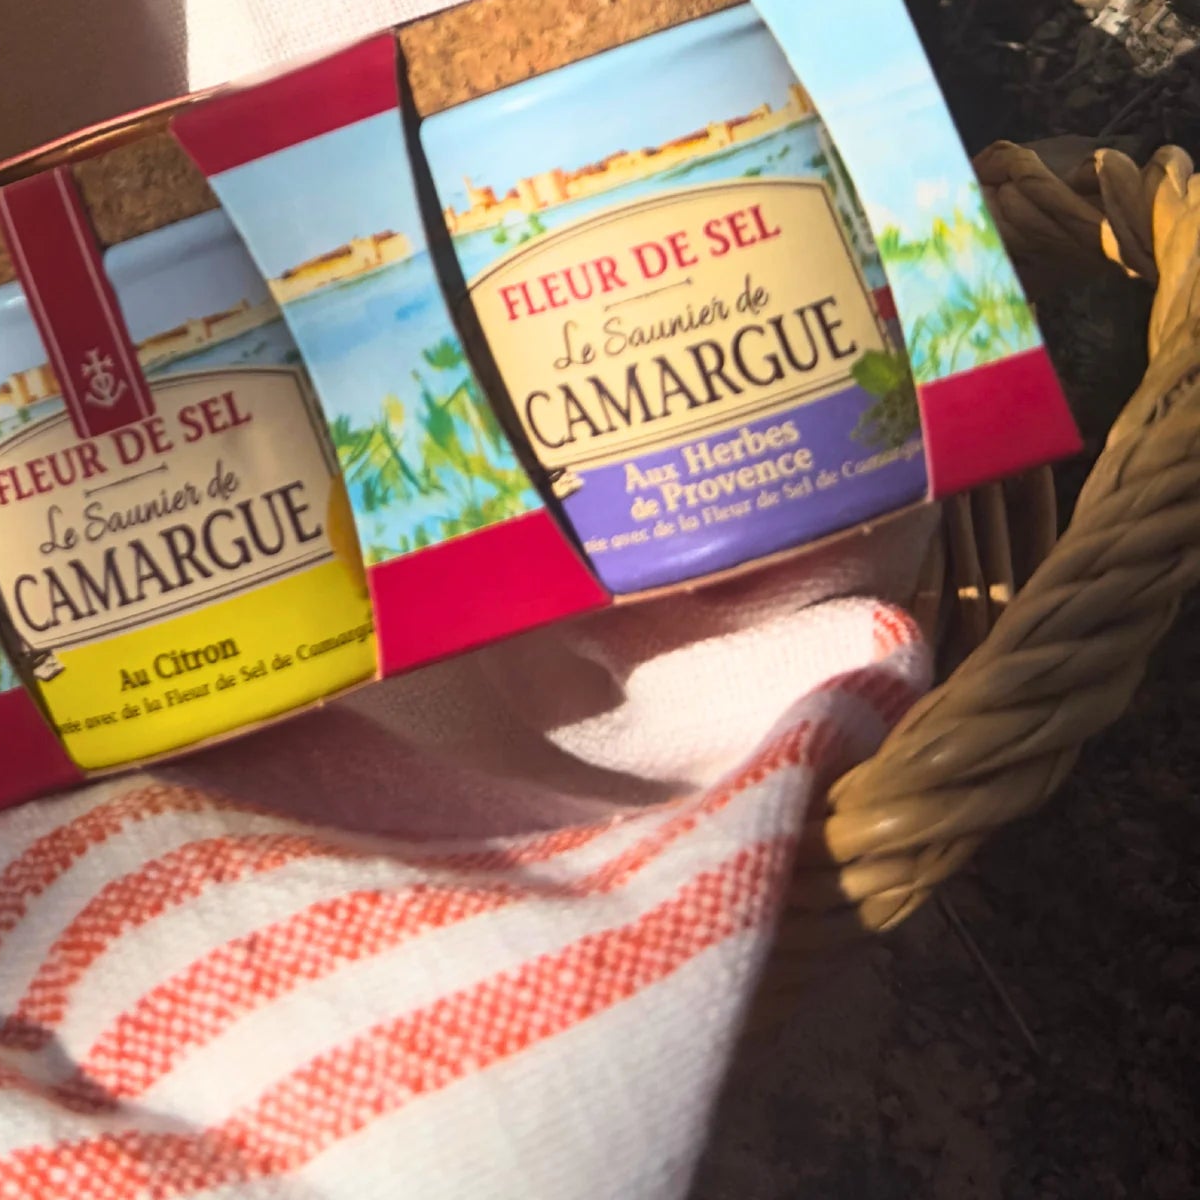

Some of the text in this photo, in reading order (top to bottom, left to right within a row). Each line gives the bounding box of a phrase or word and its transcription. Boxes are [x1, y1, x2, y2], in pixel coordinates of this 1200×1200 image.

[498, 203, 782, 322] FLEUR DE SEL
[552, 273, 770, 371] Le Saunier de
[524, 296, 857, 451] CAMARGUE
[111, 416, 175, 466] DE
[177, 391, 254, 443] SEL
[623, 418, 800, 493] Aux Herbes
[39, 459, 240, 555] Le Saunier de
[630, 447, 814, 522] de Provence
[652, 519, 676, 540] de
[677, 512, 700, 533] la
[701, 497, 752, 526] Fleur
[755, 487, 781, 509] de
[782, 475, 814, 500] Sel
[815, 468, 839, 491] de
[13, 480, 323, 632] CAMARGUE
[119, 637, 241, 692] Au Citron
[121, 702, 141, 720] de
[143, 696, 163, 716] la
[163, 680, 212, 709] Fleur
[214, 673, 237, 693] de
[239, 659, 269, 682] Sel
[271, 651, 293, 671] de
